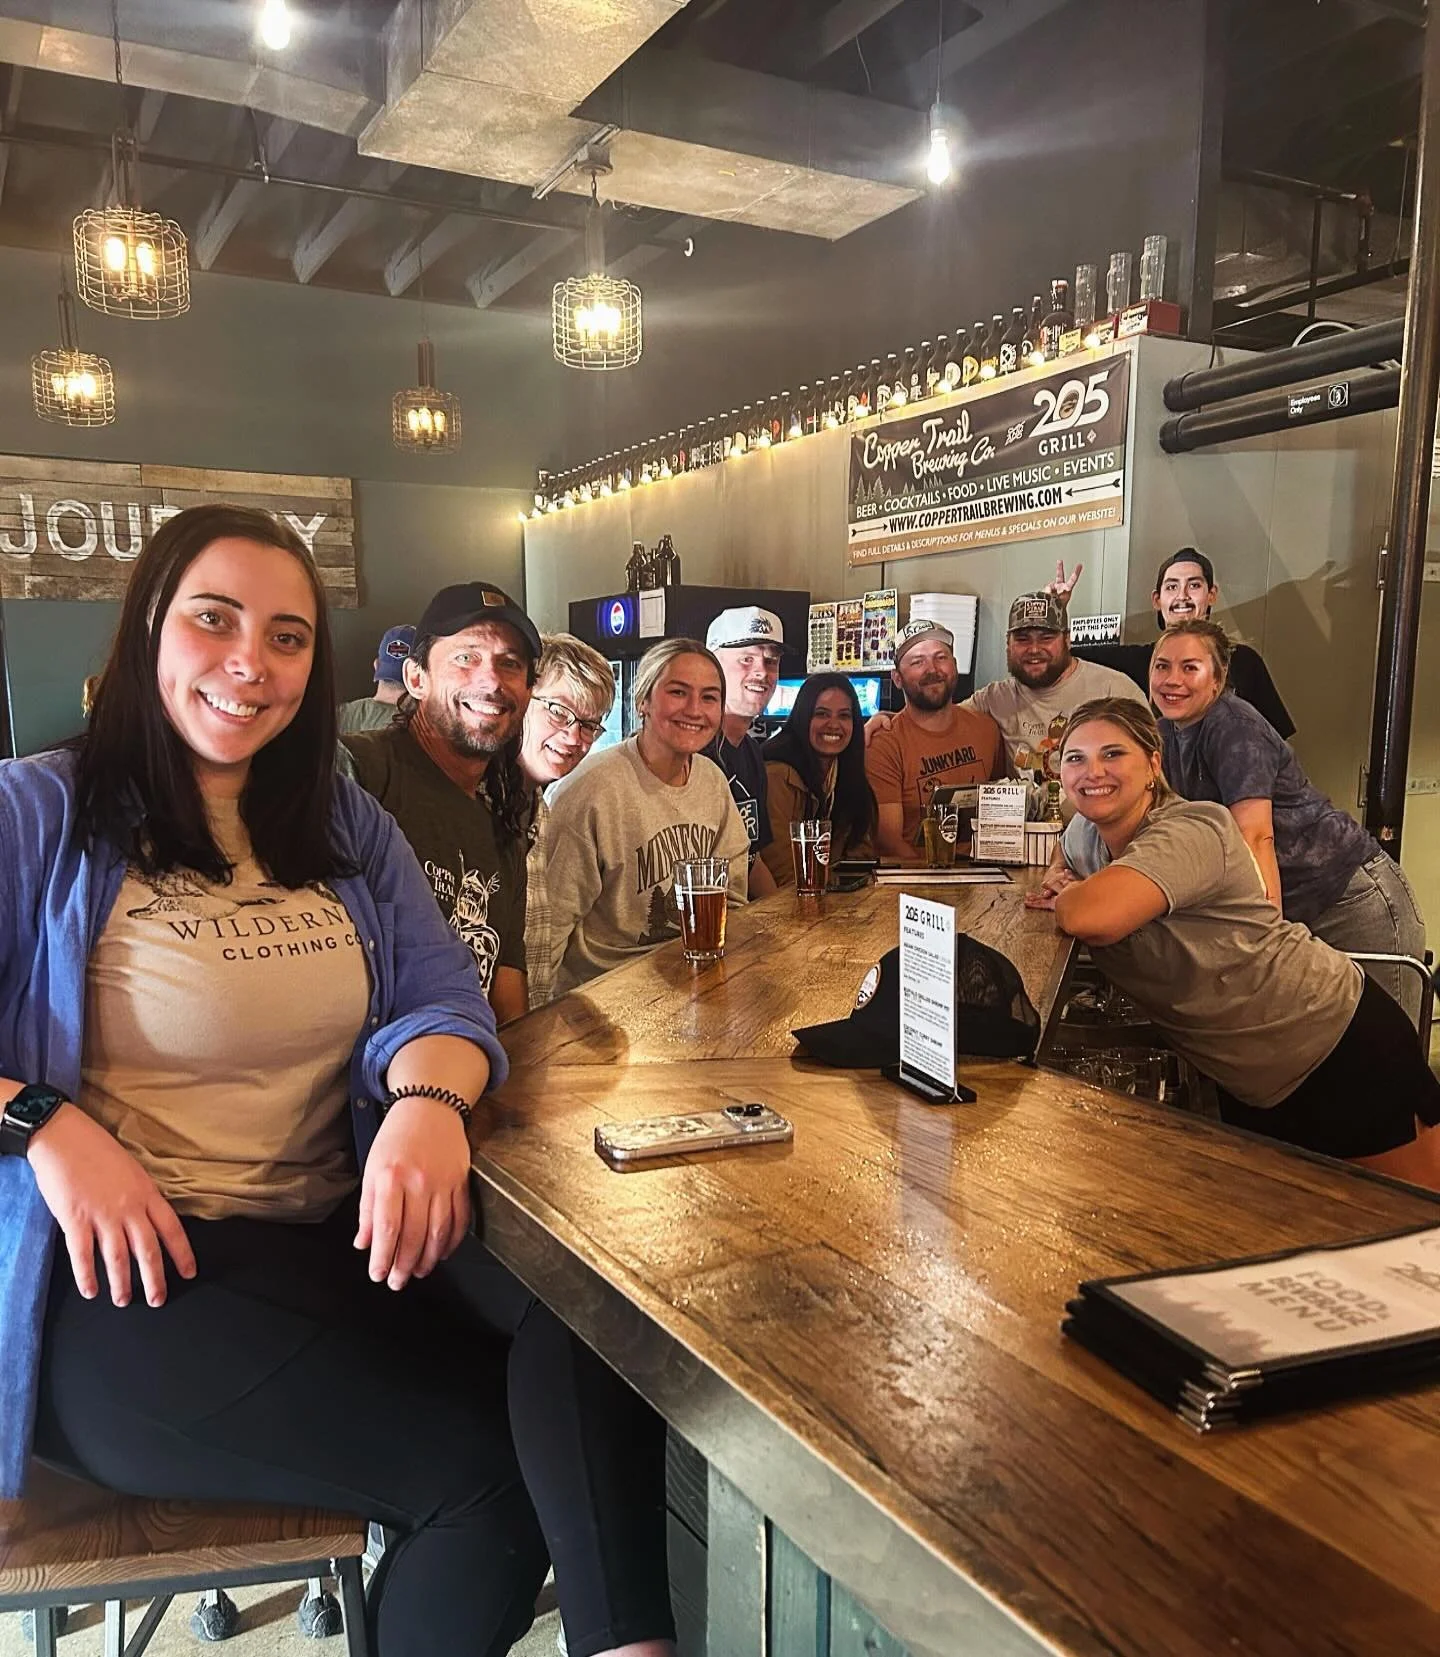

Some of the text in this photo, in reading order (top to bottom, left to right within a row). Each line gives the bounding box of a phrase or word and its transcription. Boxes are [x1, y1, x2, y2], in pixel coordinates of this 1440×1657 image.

[1029, 370, 1109, 438] 205
[1290, 394, 1320, 406] Employees
[1290, 406, 1303, 414] Only
[863, 432, 920, 472] Copper
[922, 409, 973, 454] Trail
[910, 436, 996, 479] Brewing Co.
[1038, 431, 1086, 457] GRILL
[856, 451, 1115, 518] BEER COCKTAILS FOOD LIVE MUSIC EVENTS
[0, 493, 328, 562] JOUY
[889, 486, 1063, 533] WWW.COPPERTRAILBREWING.COM
[853, 549, 867, 559] FIND
[868, 547, 881, 556] FULL
[882, 542, 906, 555] DETAILS
[911, 534, 958, 549] DESCRIPTIONS
[959, 531, 973, 542] FOR
[974, 527, 1001, 540] MENUS
[1001, 526, 1008, 536] &
[1008, 520, 1041, 535] SPECIALS
[1043, 517, 1057, 529] ON
[1058, 514, 1077, 526] OUR
[1078, 506, 1117, 522] WEBSITE!
[1072, 616, 1119, 626] EMPLOYEES ONLY
[920, 746, 977, 776] JUNKYARD
[996, 786, 1020, 796] GRILL
[636, 823, 716, 895] MINNESOT
[167, 905, 350, 941] WILDERN
[905, 904, 945, 932] 205 GRILL
[222, 936, 338, 961] CLOTHING
[1238, 1282, 1347, 1332] MENU
[1295, 1270, 1388, 1313] FOOD
